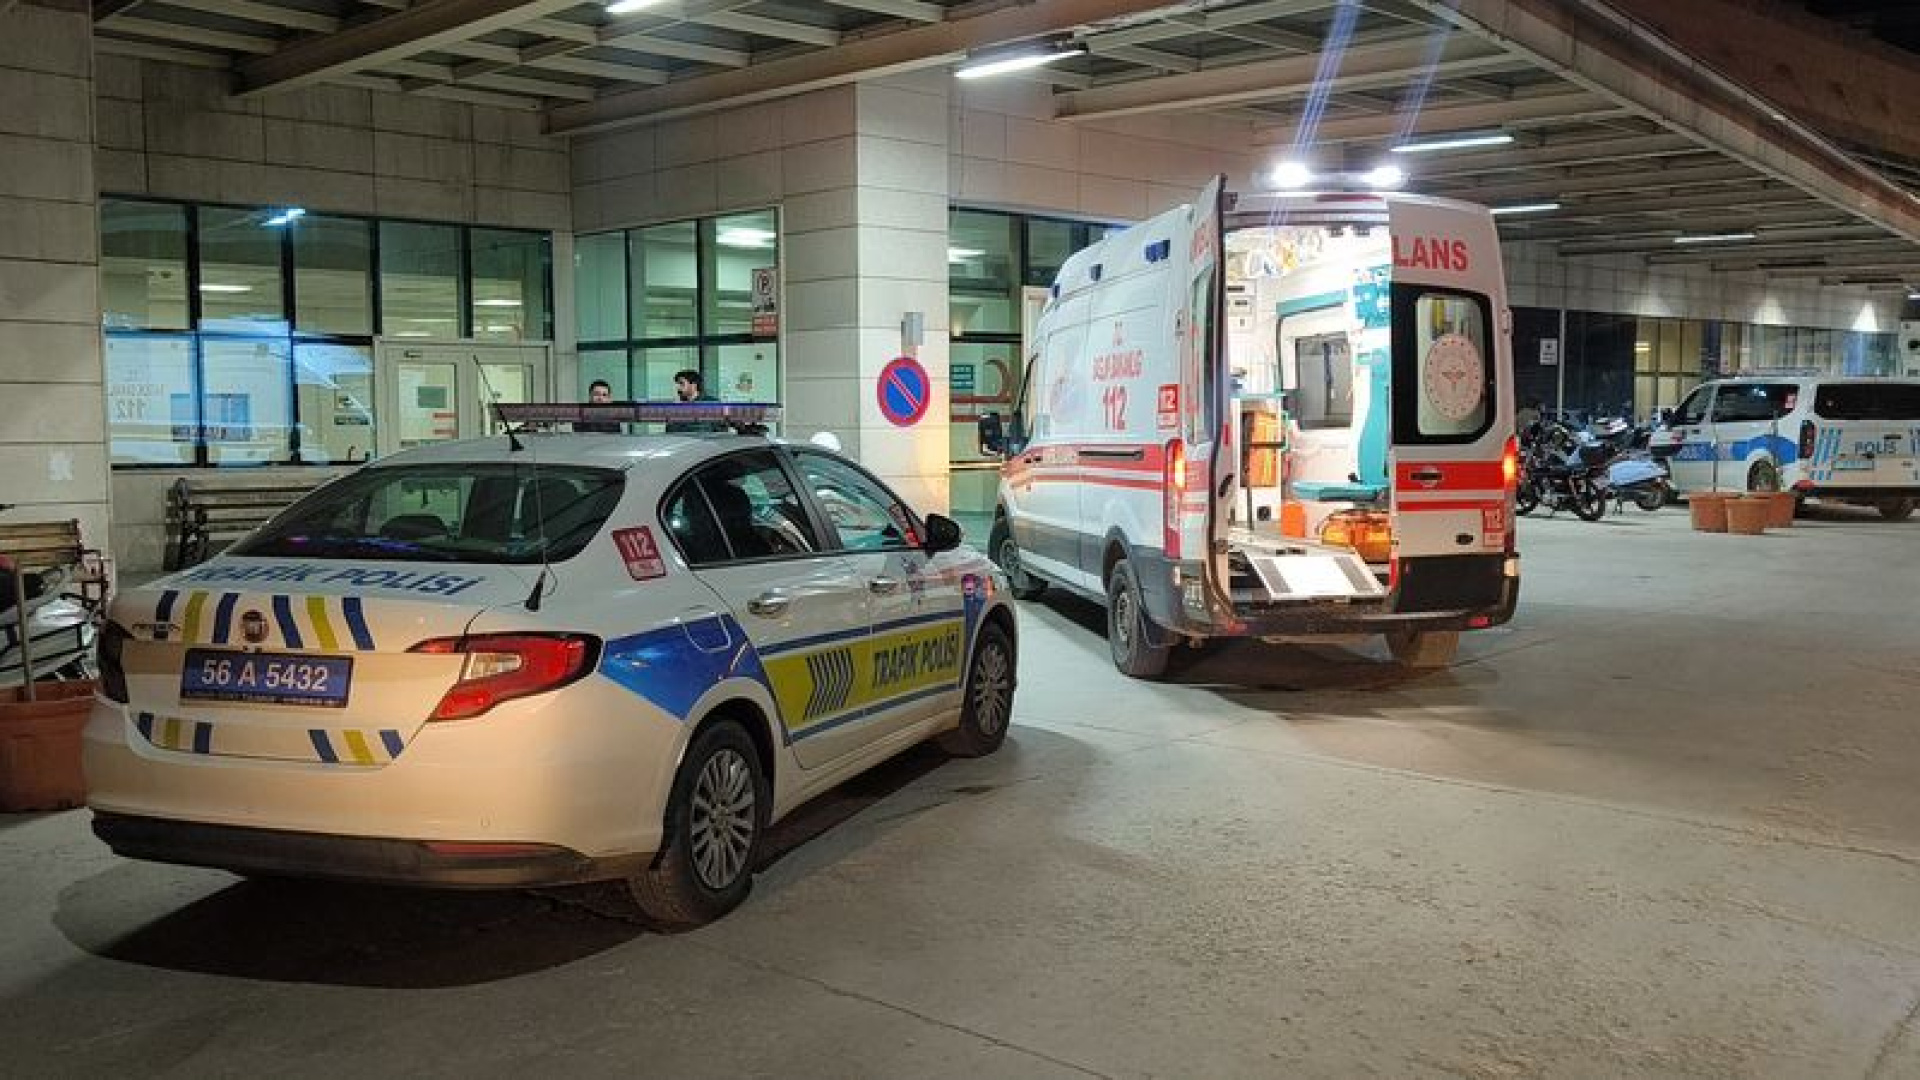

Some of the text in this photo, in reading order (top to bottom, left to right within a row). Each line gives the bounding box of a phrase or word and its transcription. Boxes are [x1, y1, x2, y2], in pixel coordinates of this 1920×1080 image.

[1392, 234, 1468, 272] LANS
[1102, 385, 1127, 430] 112
[619, 532, 655, 558] 112
[201, 658, 328, 692] 56 A 5432
